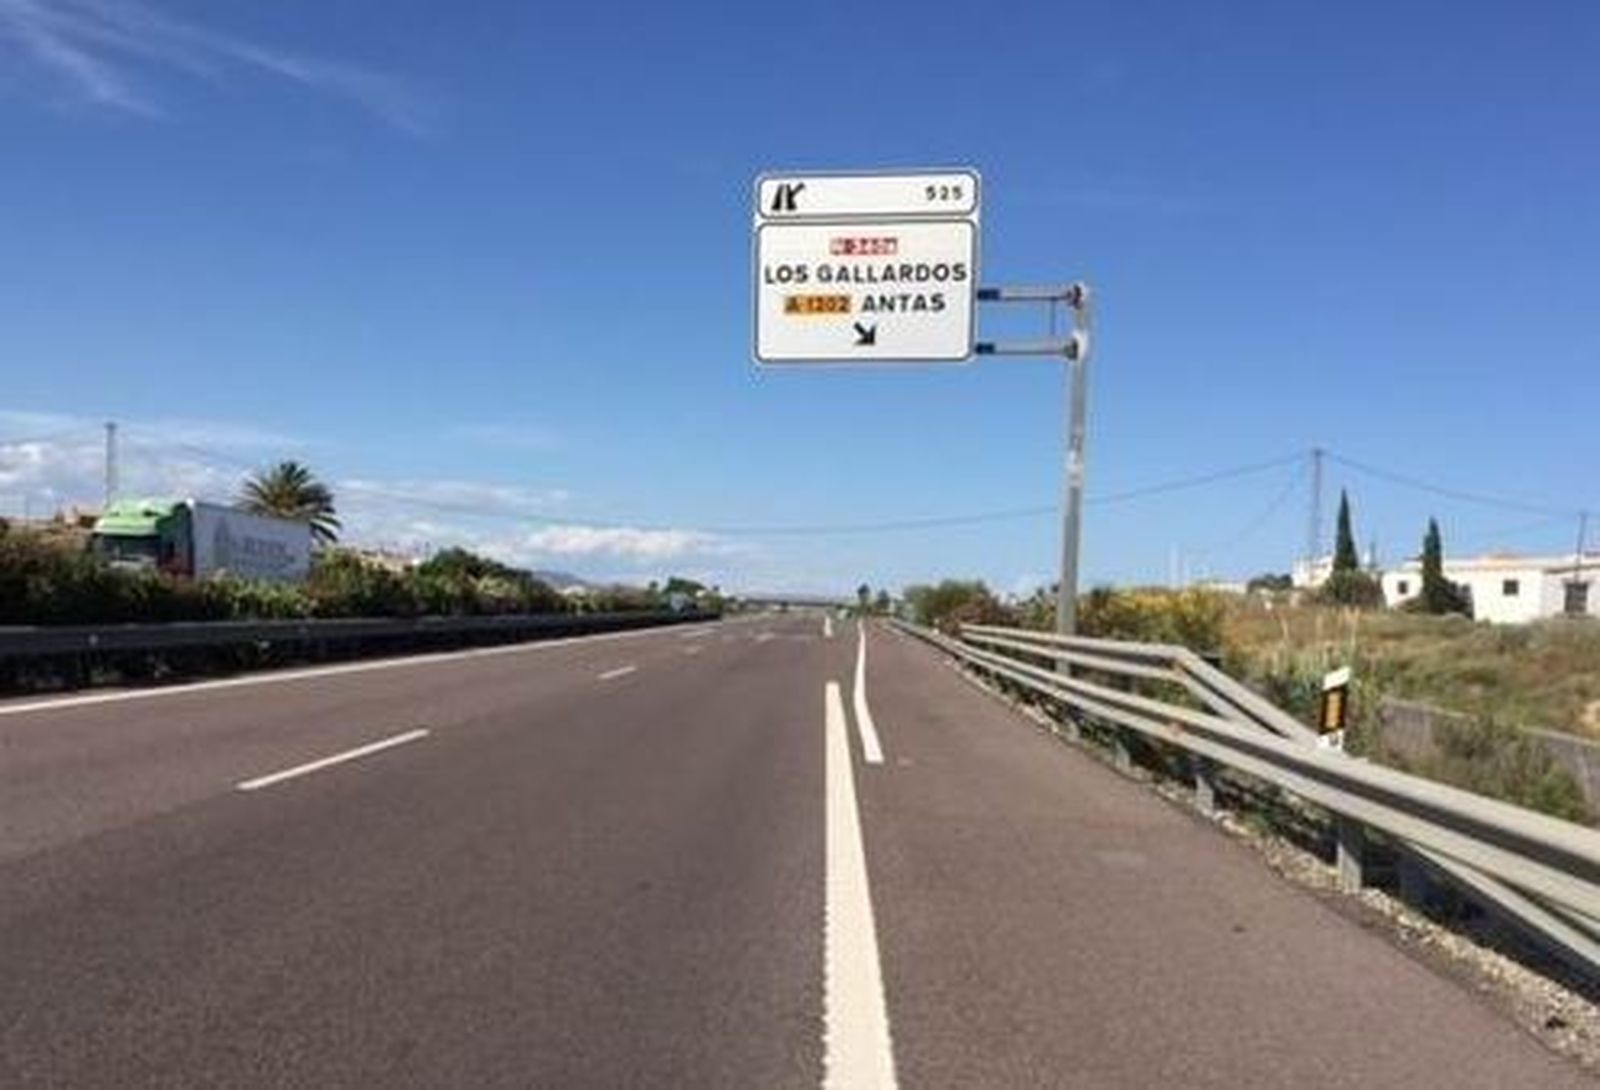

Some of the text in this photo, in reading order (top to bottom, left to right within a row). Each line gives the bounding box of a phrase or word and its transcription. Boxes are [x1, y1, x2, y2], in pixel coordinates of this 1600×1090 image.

[925, 185, 964, 201] 525
[765, 263, 967, 284] LOS GALLARDOS
[861, 294, 947, 312] ANTAS
